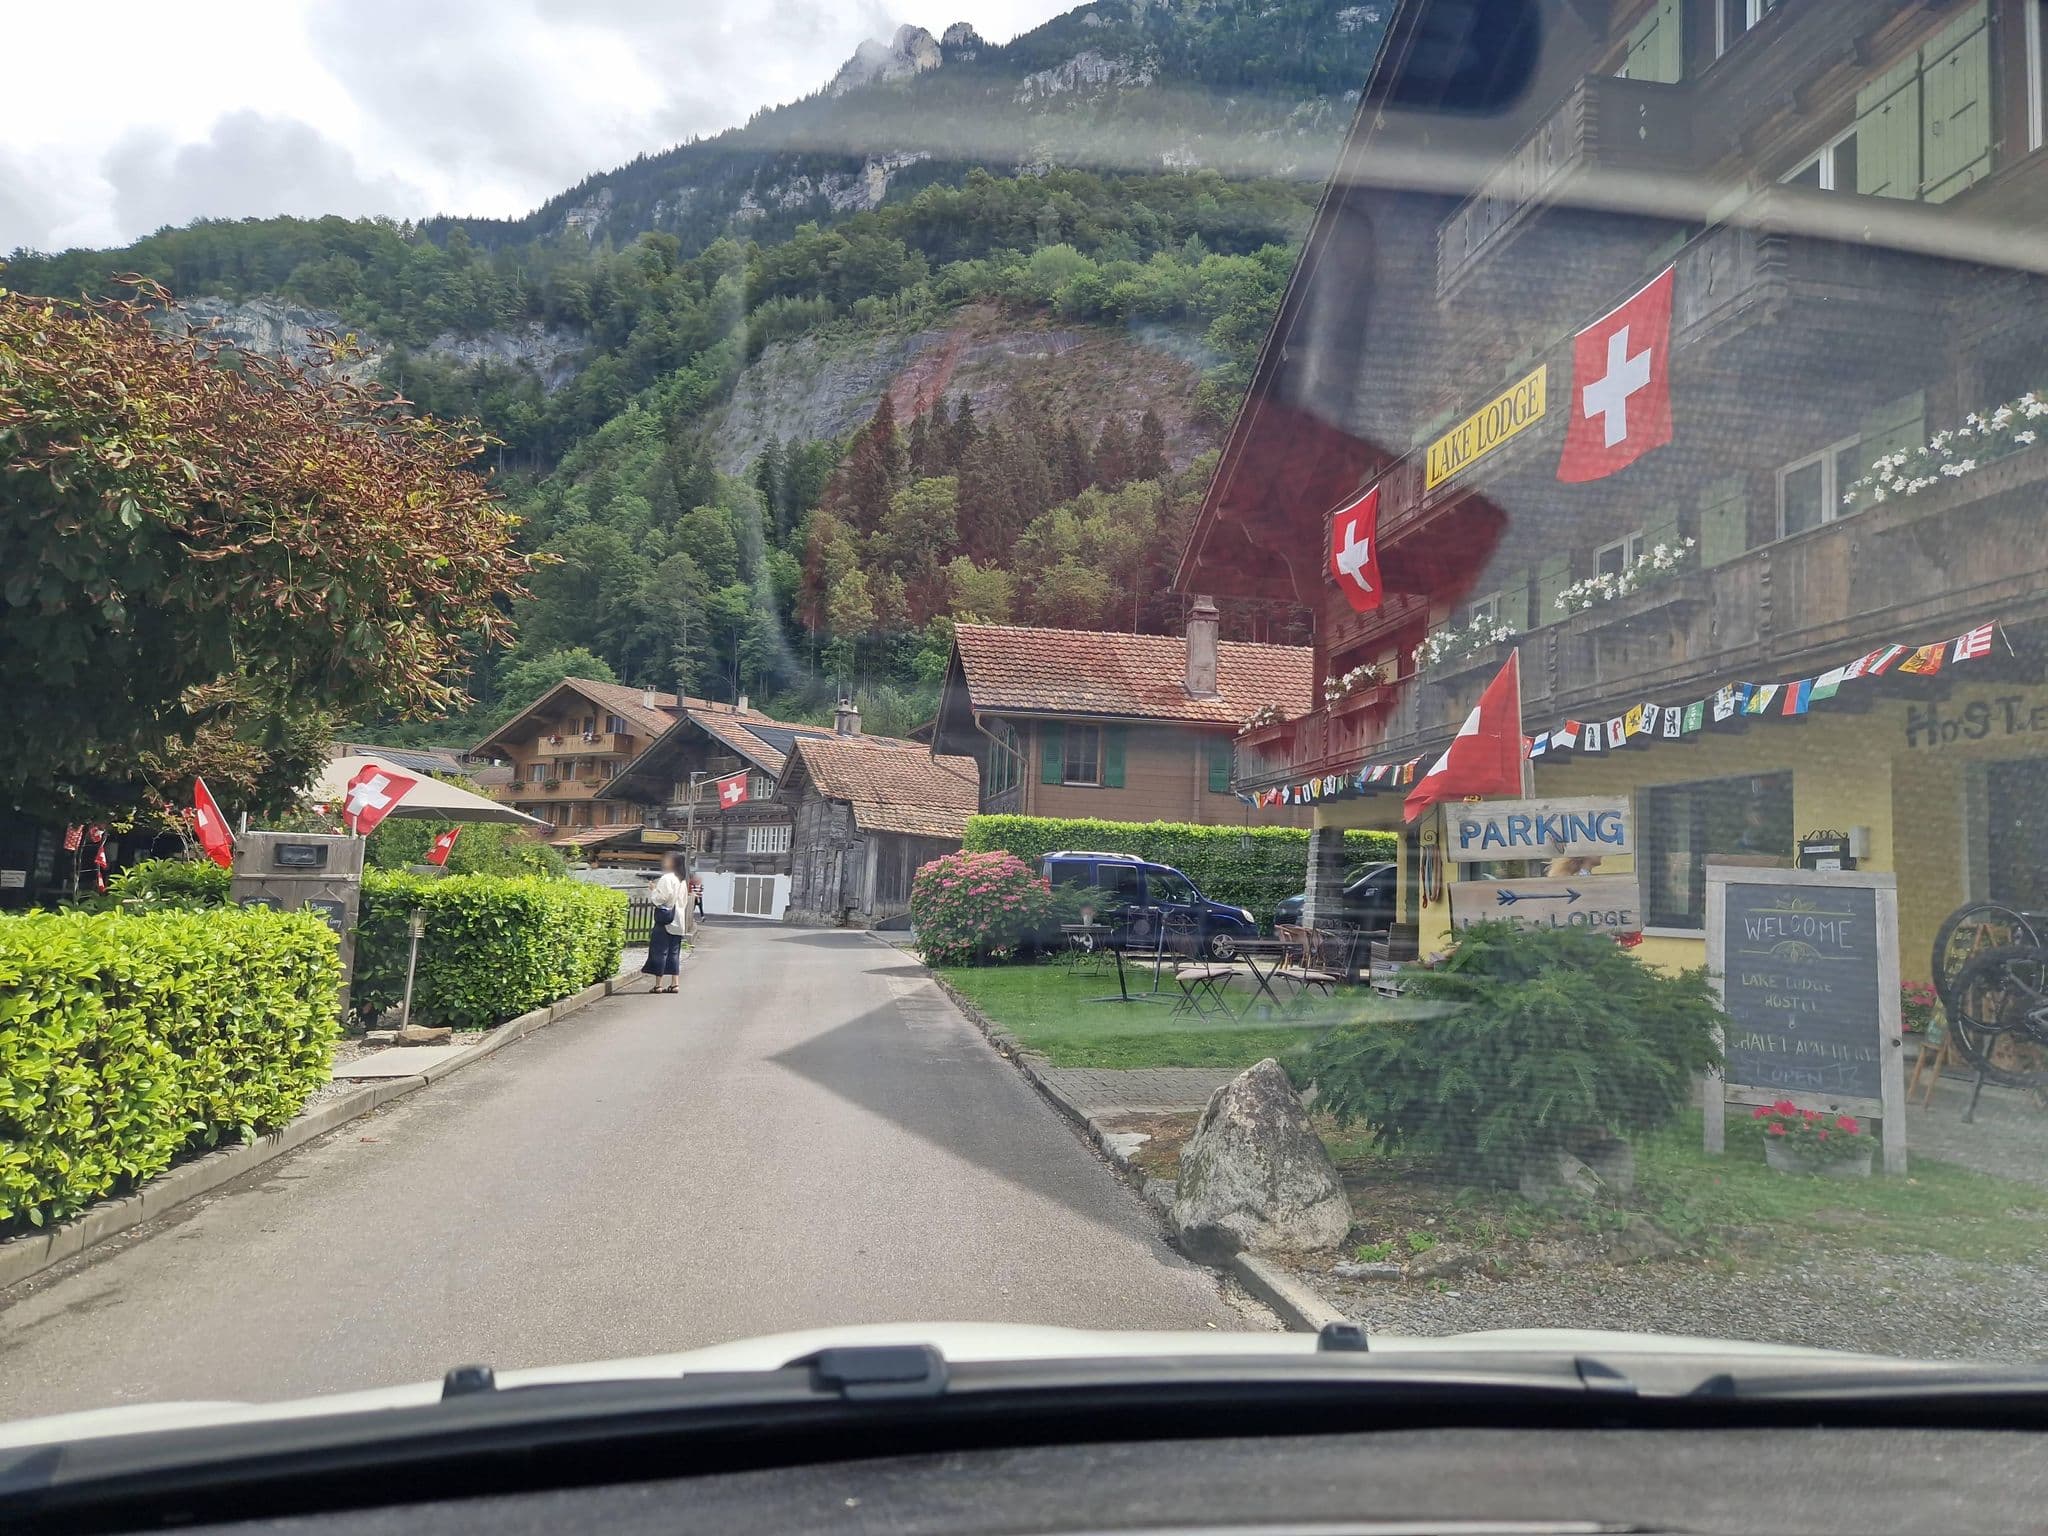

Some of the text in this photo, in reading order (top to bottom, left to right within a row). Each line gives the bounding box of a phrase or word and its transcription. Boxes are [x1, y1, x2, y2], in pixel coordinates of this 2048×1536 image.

[1432, 376, 1539, 482] LAKE LODGE
[1459, 811, 1625, 850] PARKING
[1550, 910, 1633, 930] LODGE
[1744, 914, 1854, 949] WELCOME
[1741, 972, 1778, 988] LAKE
